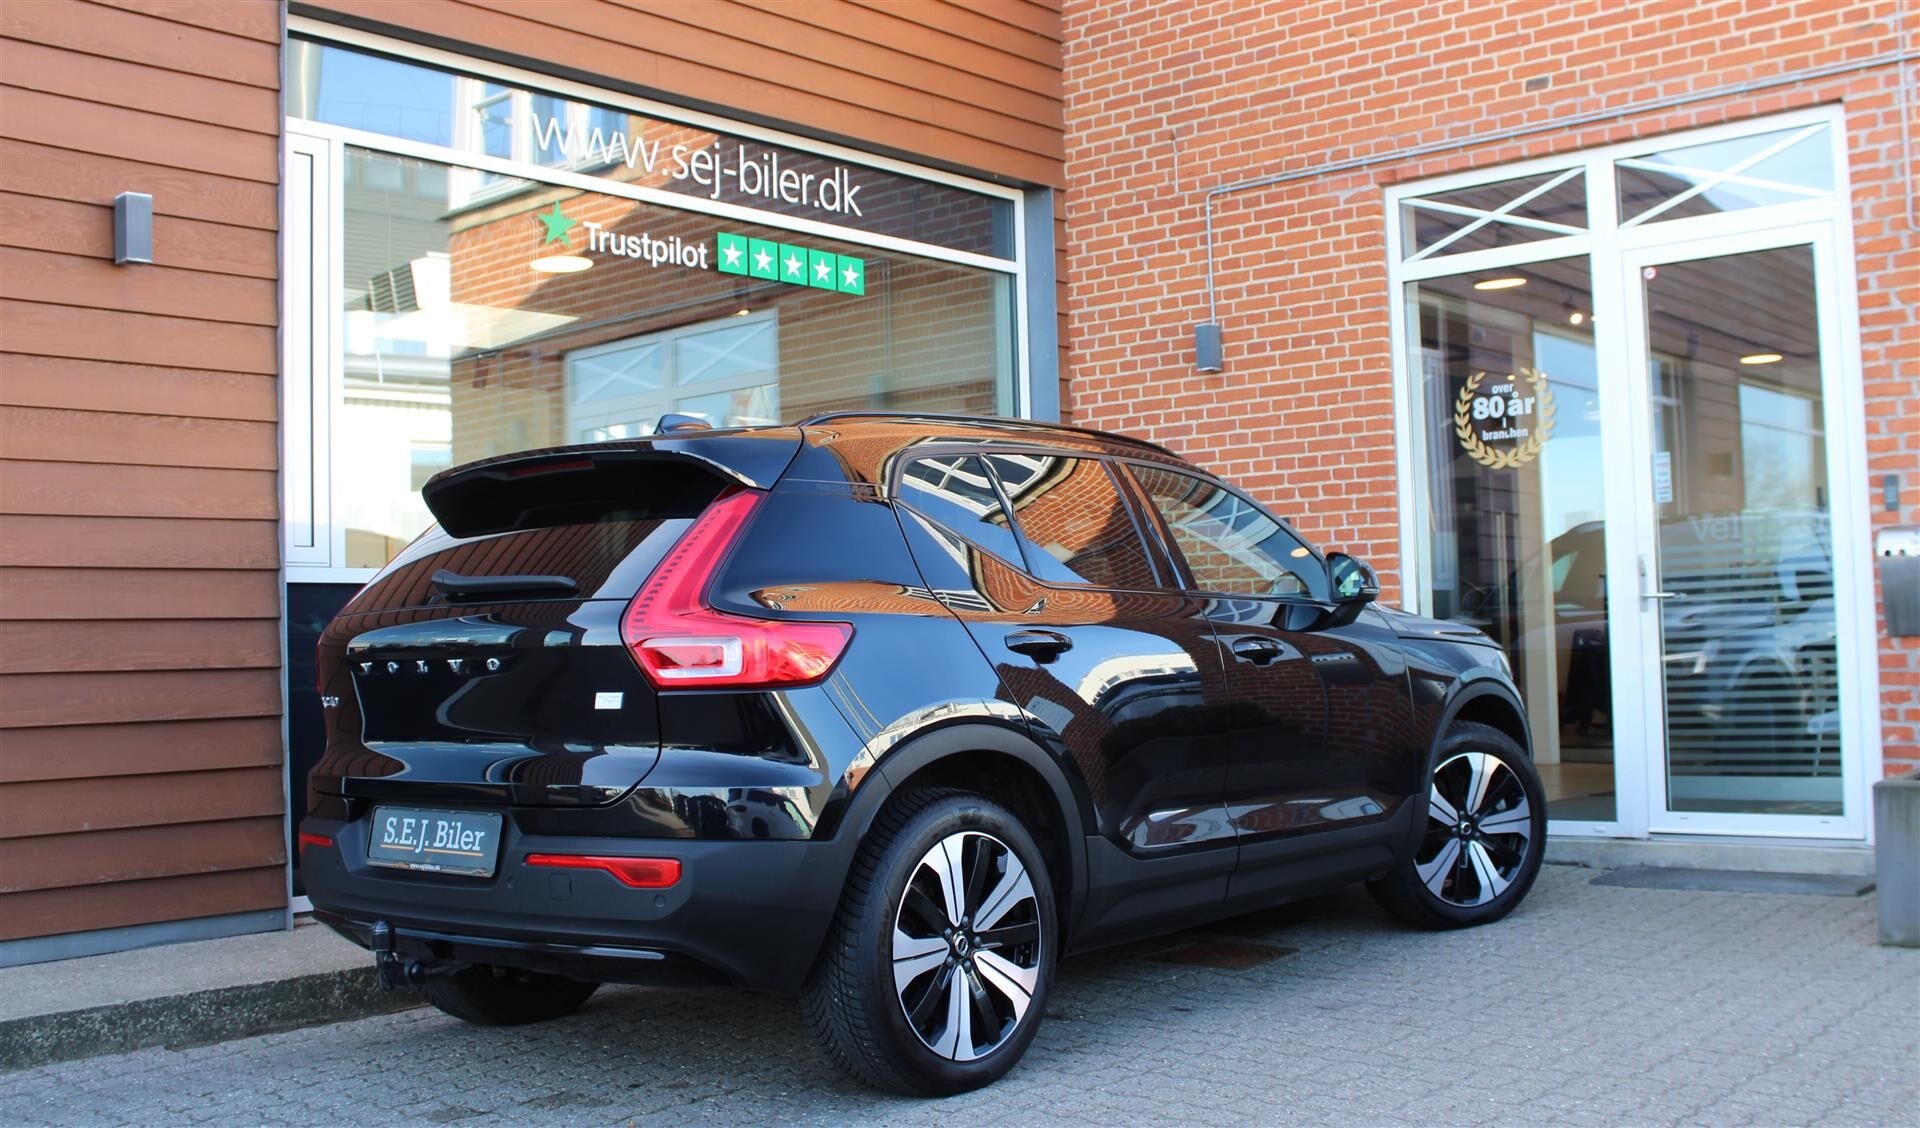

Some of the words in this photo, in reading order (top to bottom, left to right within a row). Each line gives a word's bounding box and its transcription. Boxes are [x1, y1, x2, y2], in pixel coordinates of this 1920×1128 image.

[531, 113, 862, 217] www.sej-biler.dk
[583, 220, 709, 270] Trustpilot
[1473, 396, 1505, 419] 80
[1507, 391, 1535, 416] år
[1492, 384, 1514, 394] over
[360, 657, 500, 674] VOLVO
[383, 816, 429, 853] S.E.J.
[433, 820, 485, 851] Biler
